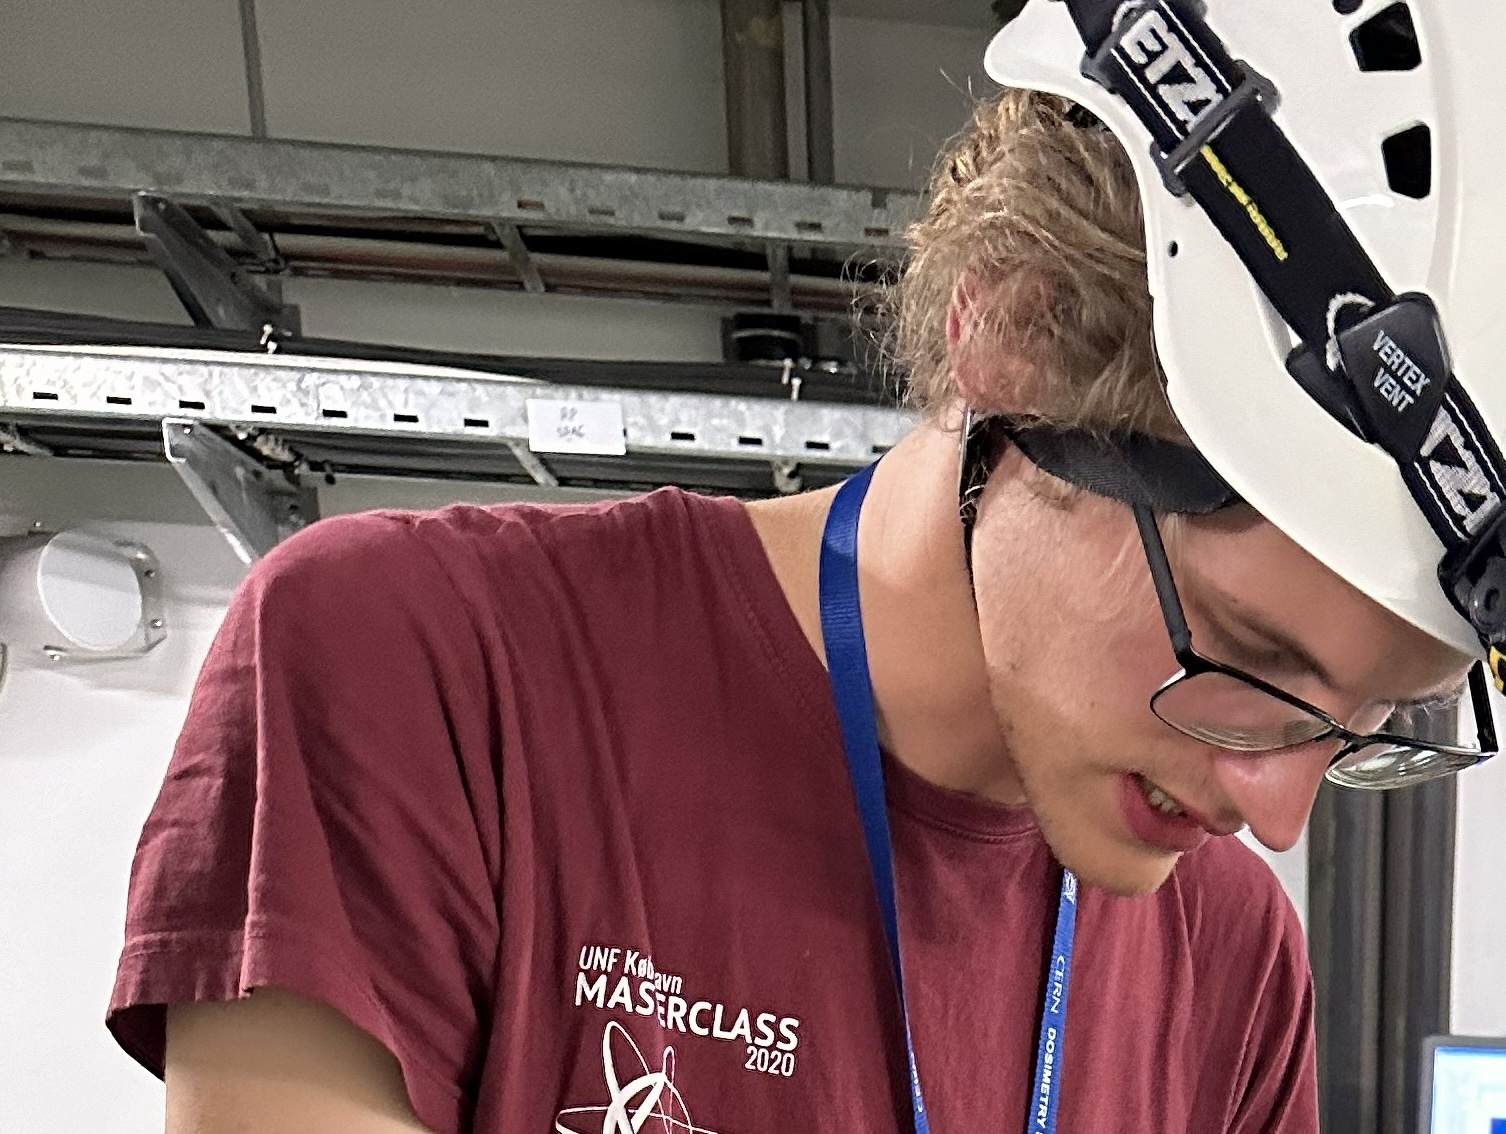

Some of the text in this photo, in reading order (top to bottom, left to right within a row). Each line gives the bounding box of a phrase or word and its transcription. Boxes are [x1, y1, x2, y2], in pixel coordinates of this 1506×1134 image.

[1119, 8, 1224, 134] ETZL
[1372, 329, 1431, 398] VERTEX
[1373, 367, 1415, 412] VENT
[1420, 404, 1502, 536] TZL
[579, 945, 683, 995] UNF Købavn
[1050, 954, 1065, 1014] CERN
[575, 971, 800, 1052] MASERCLASS
[744, 1045, 795, 1077] 2020
[1036, 1027, 1057, 1129] DOSIMETRY
